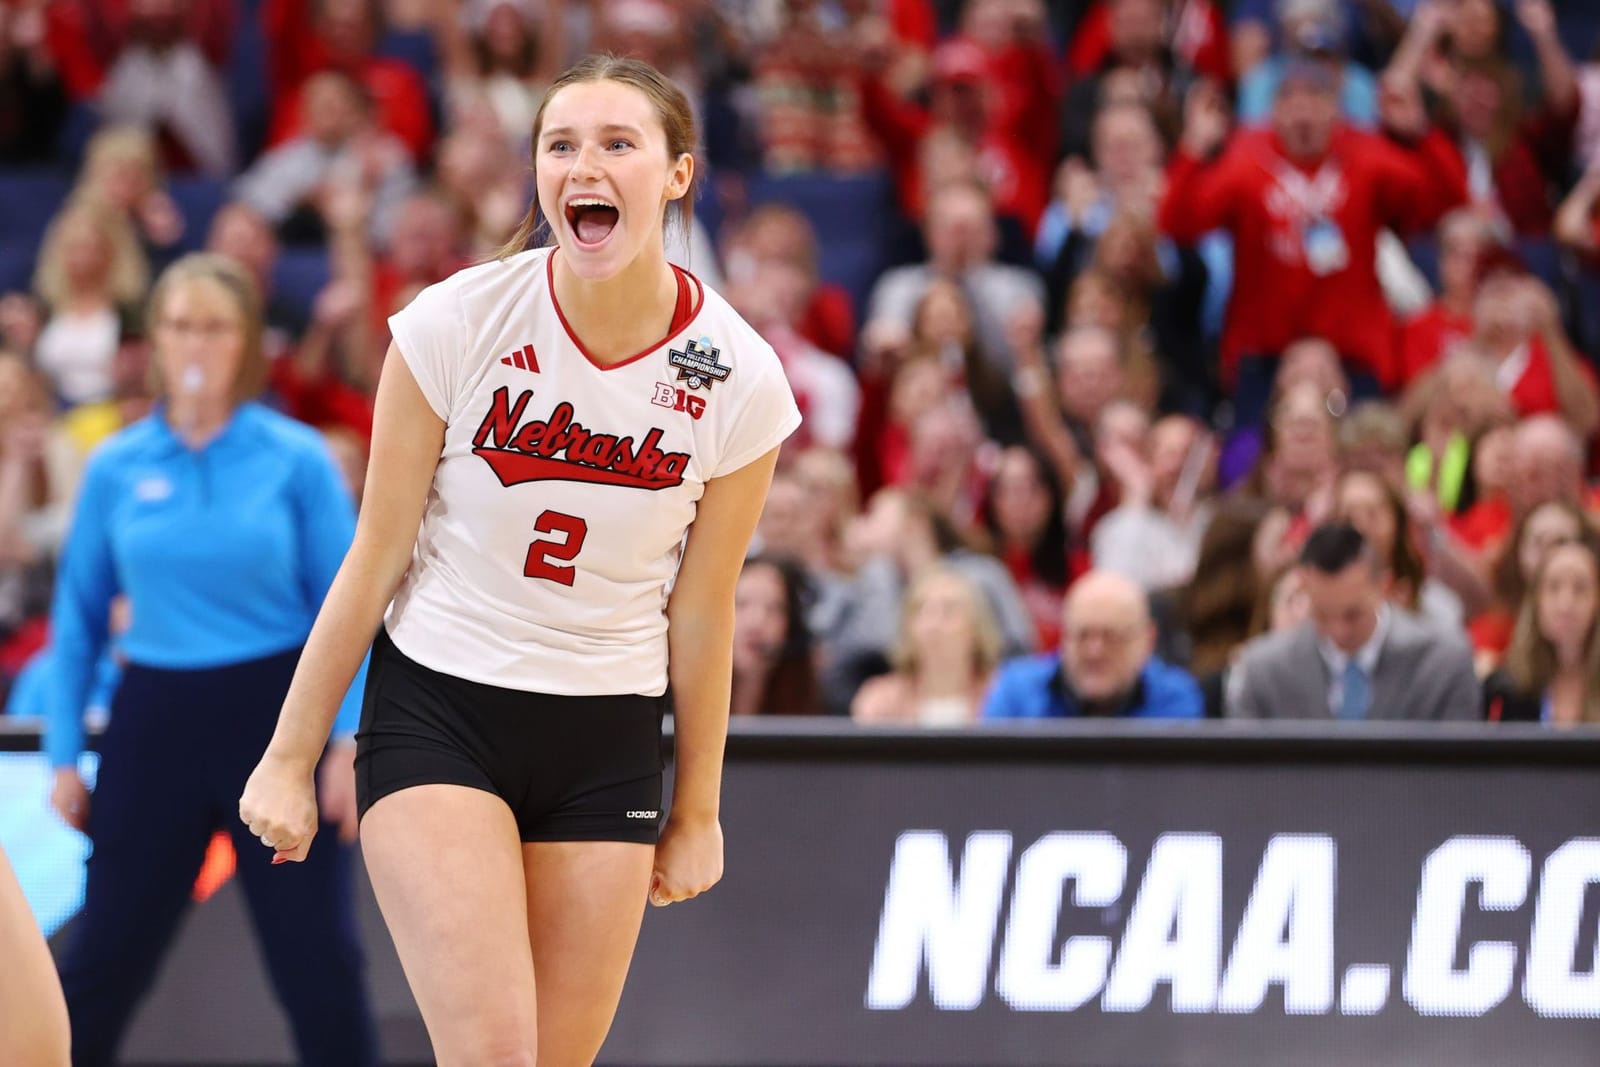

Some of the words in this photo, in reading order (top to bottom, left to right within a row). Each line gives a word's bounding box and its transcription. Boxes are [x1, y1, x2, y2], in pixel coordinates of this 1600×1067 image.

[672, 355, 727, 378] CHAMPIONSHIP
[472, 386, 692, 482] Nebraska
[523, 509, 588, 586] 2
